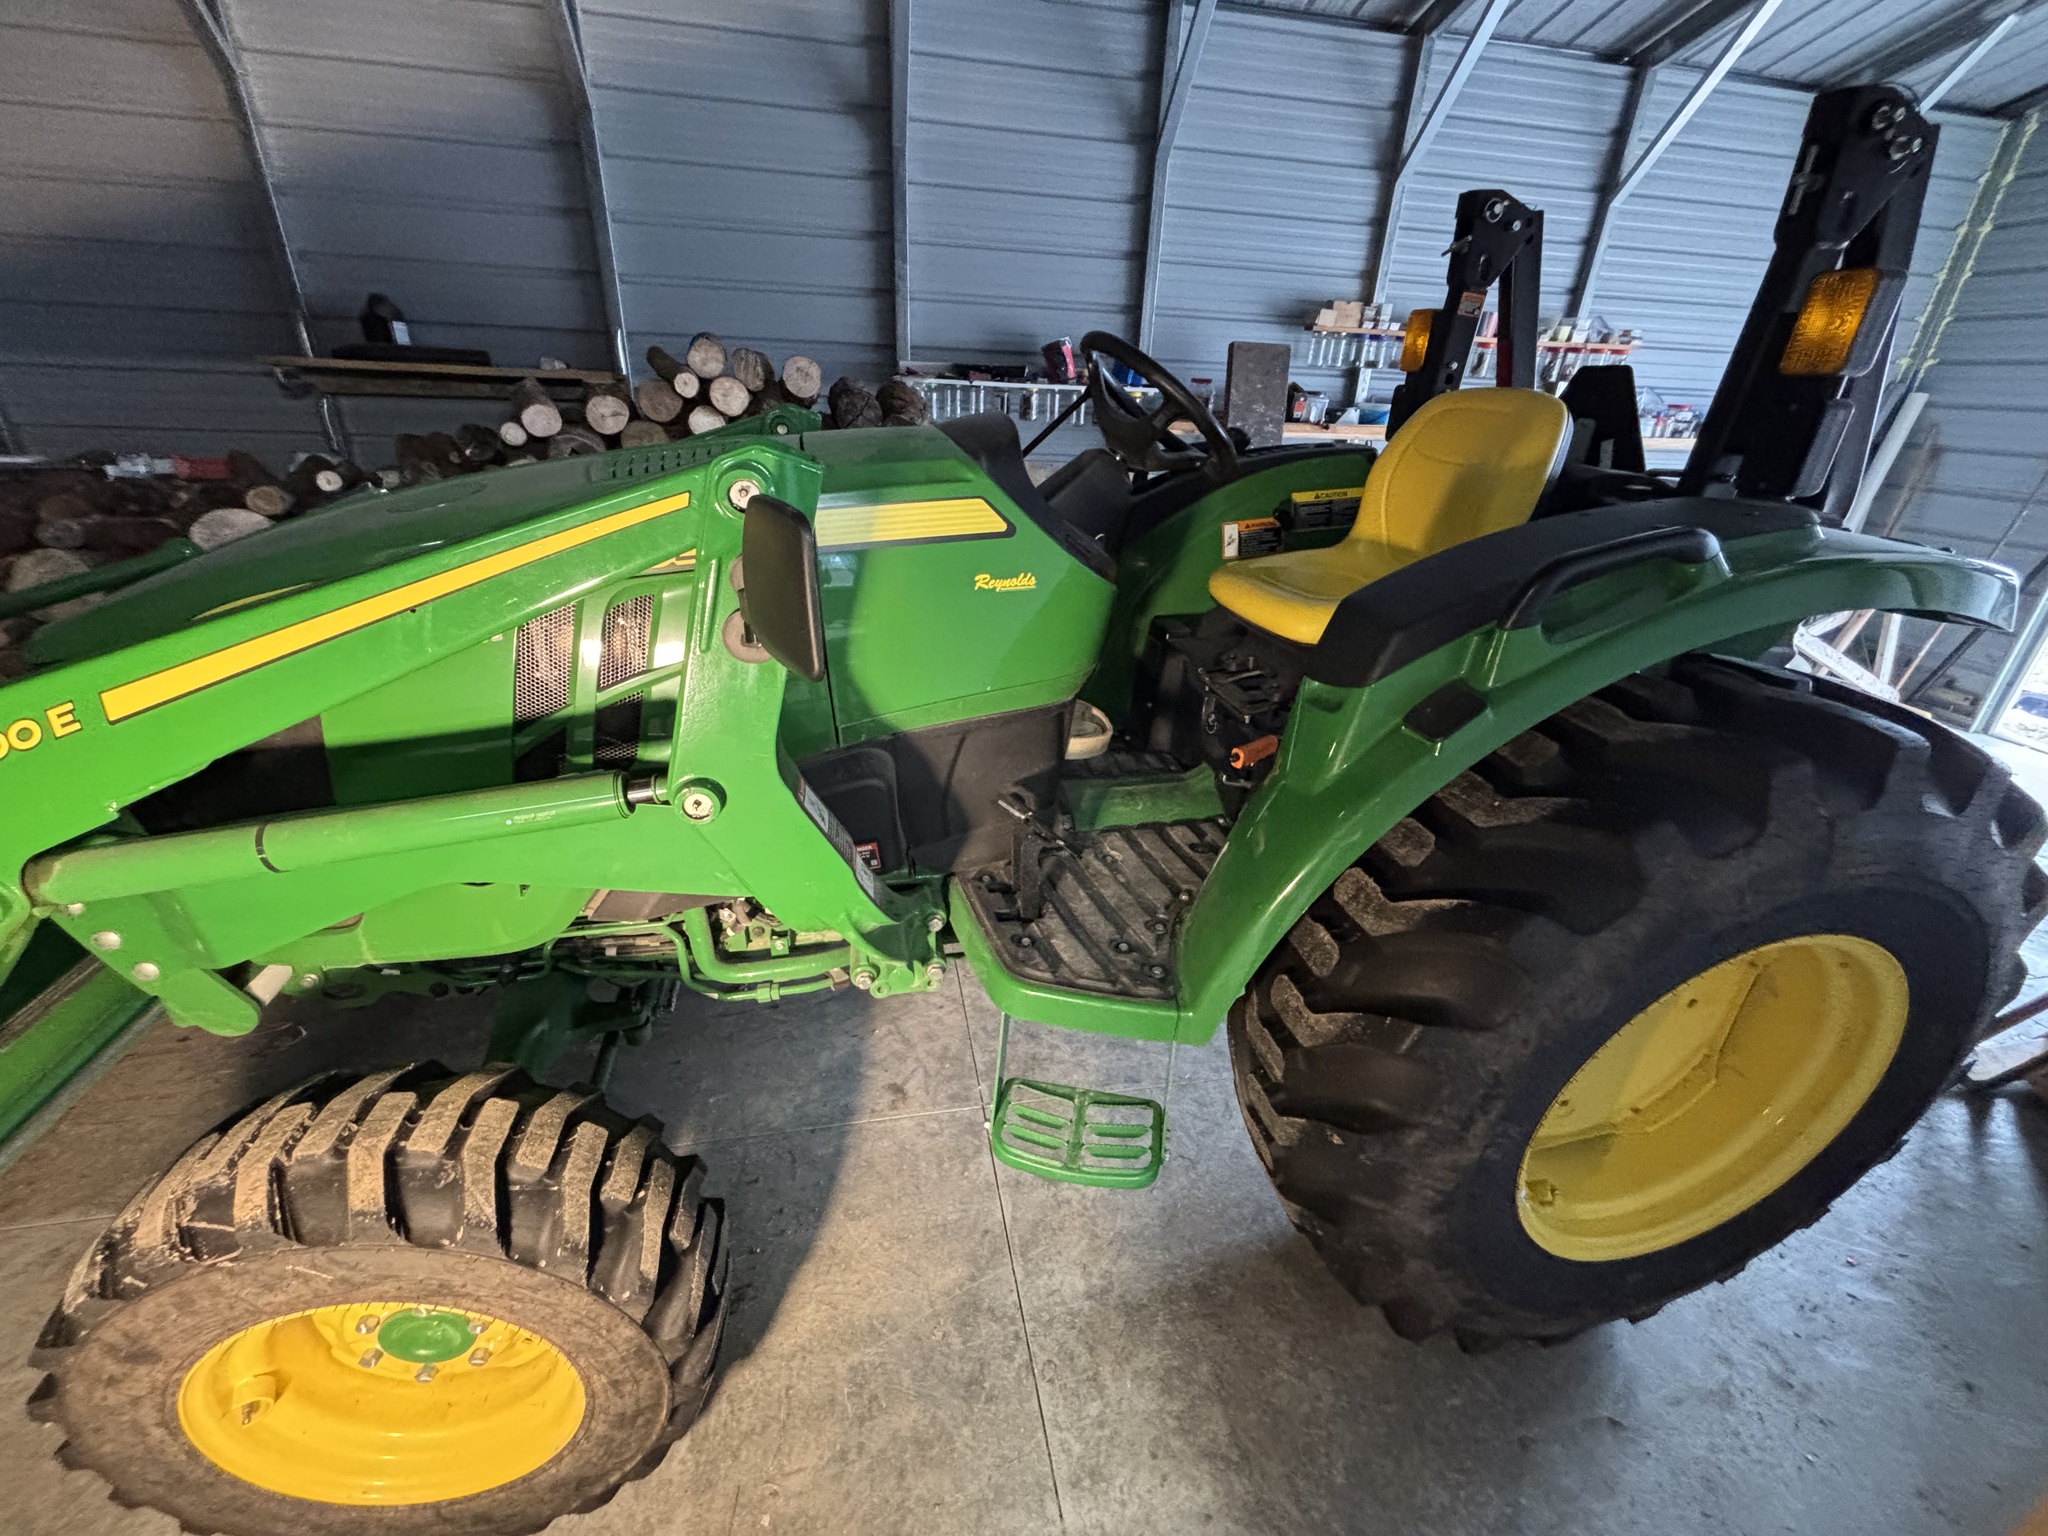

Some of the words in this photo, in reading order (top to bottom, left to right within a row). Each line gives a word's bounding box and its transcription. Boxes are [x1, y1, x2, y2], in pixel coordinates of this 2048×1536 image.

[1320, 491, 1348, 499] CAUTION
[974, 572, 1036, 592] Reynolds
[0, 701, 82, 760] 0E
